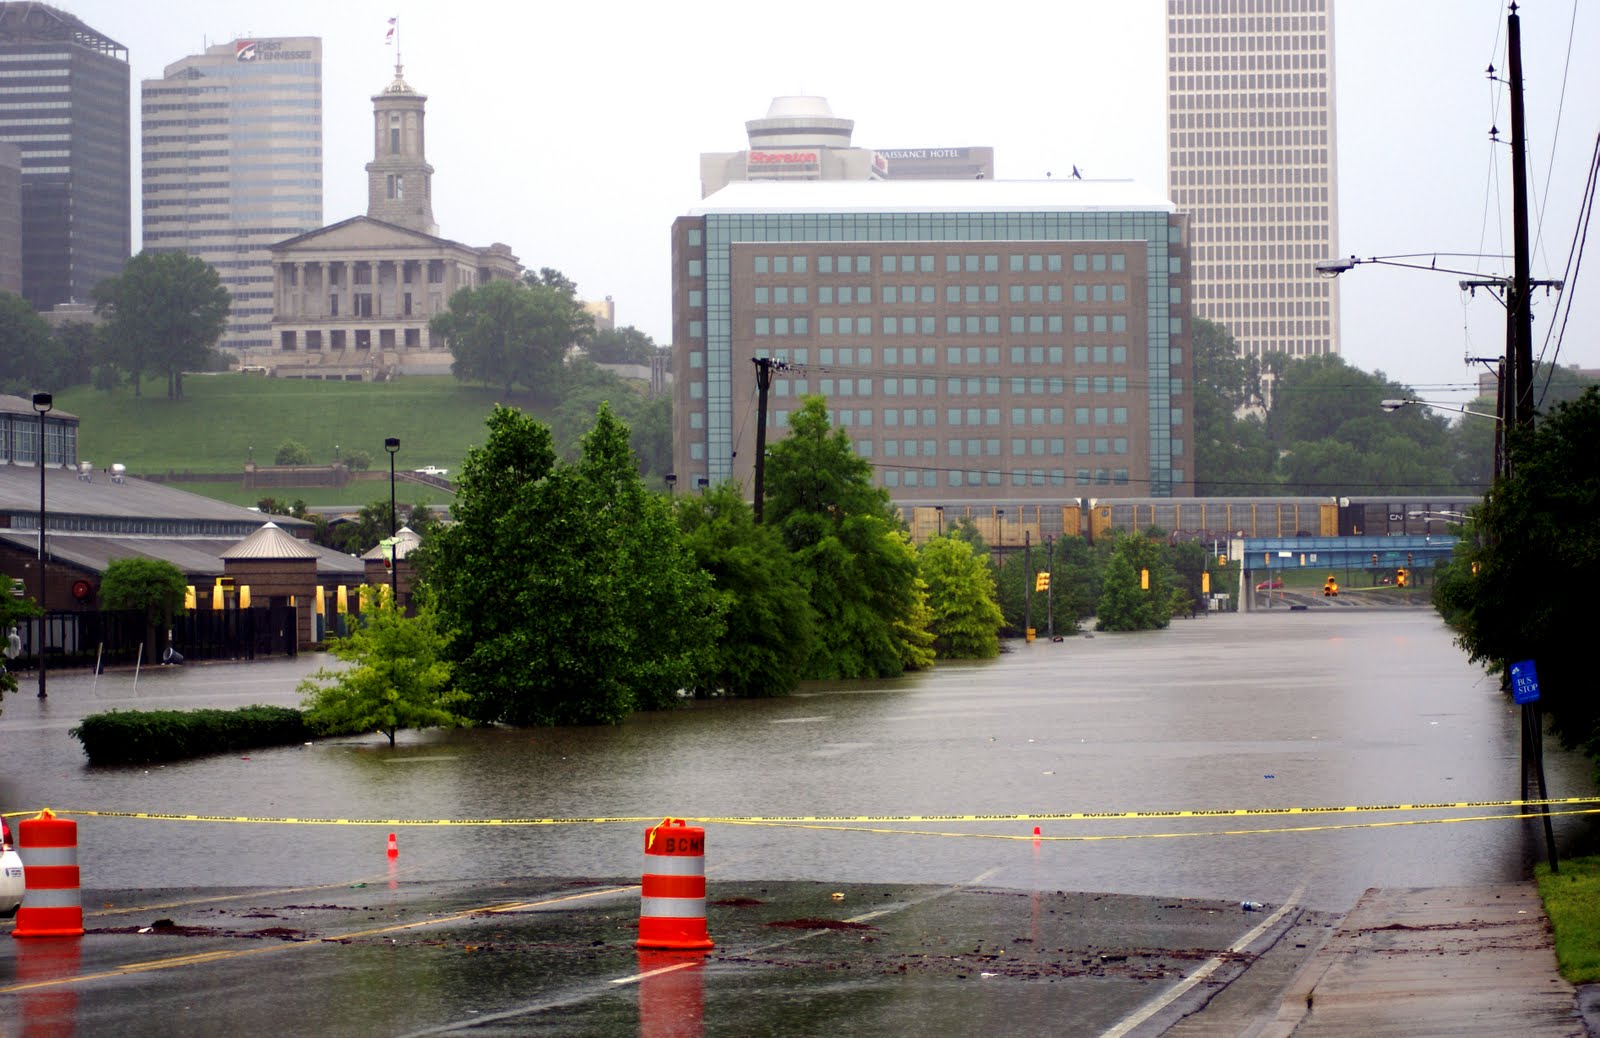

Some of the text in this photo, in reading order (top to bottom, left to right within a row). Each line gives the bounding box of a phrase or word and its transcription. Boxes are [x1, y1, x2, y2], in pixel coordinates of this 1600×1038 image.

[256, 50, 312, 60] TENNESSEE
[751, 151, 817, 163] Sheraton
[930, 149, 960, 158] HOTEL
[1517, 676, 1533, 687] BUS
[1518, 683, 1538, 695] STOP
